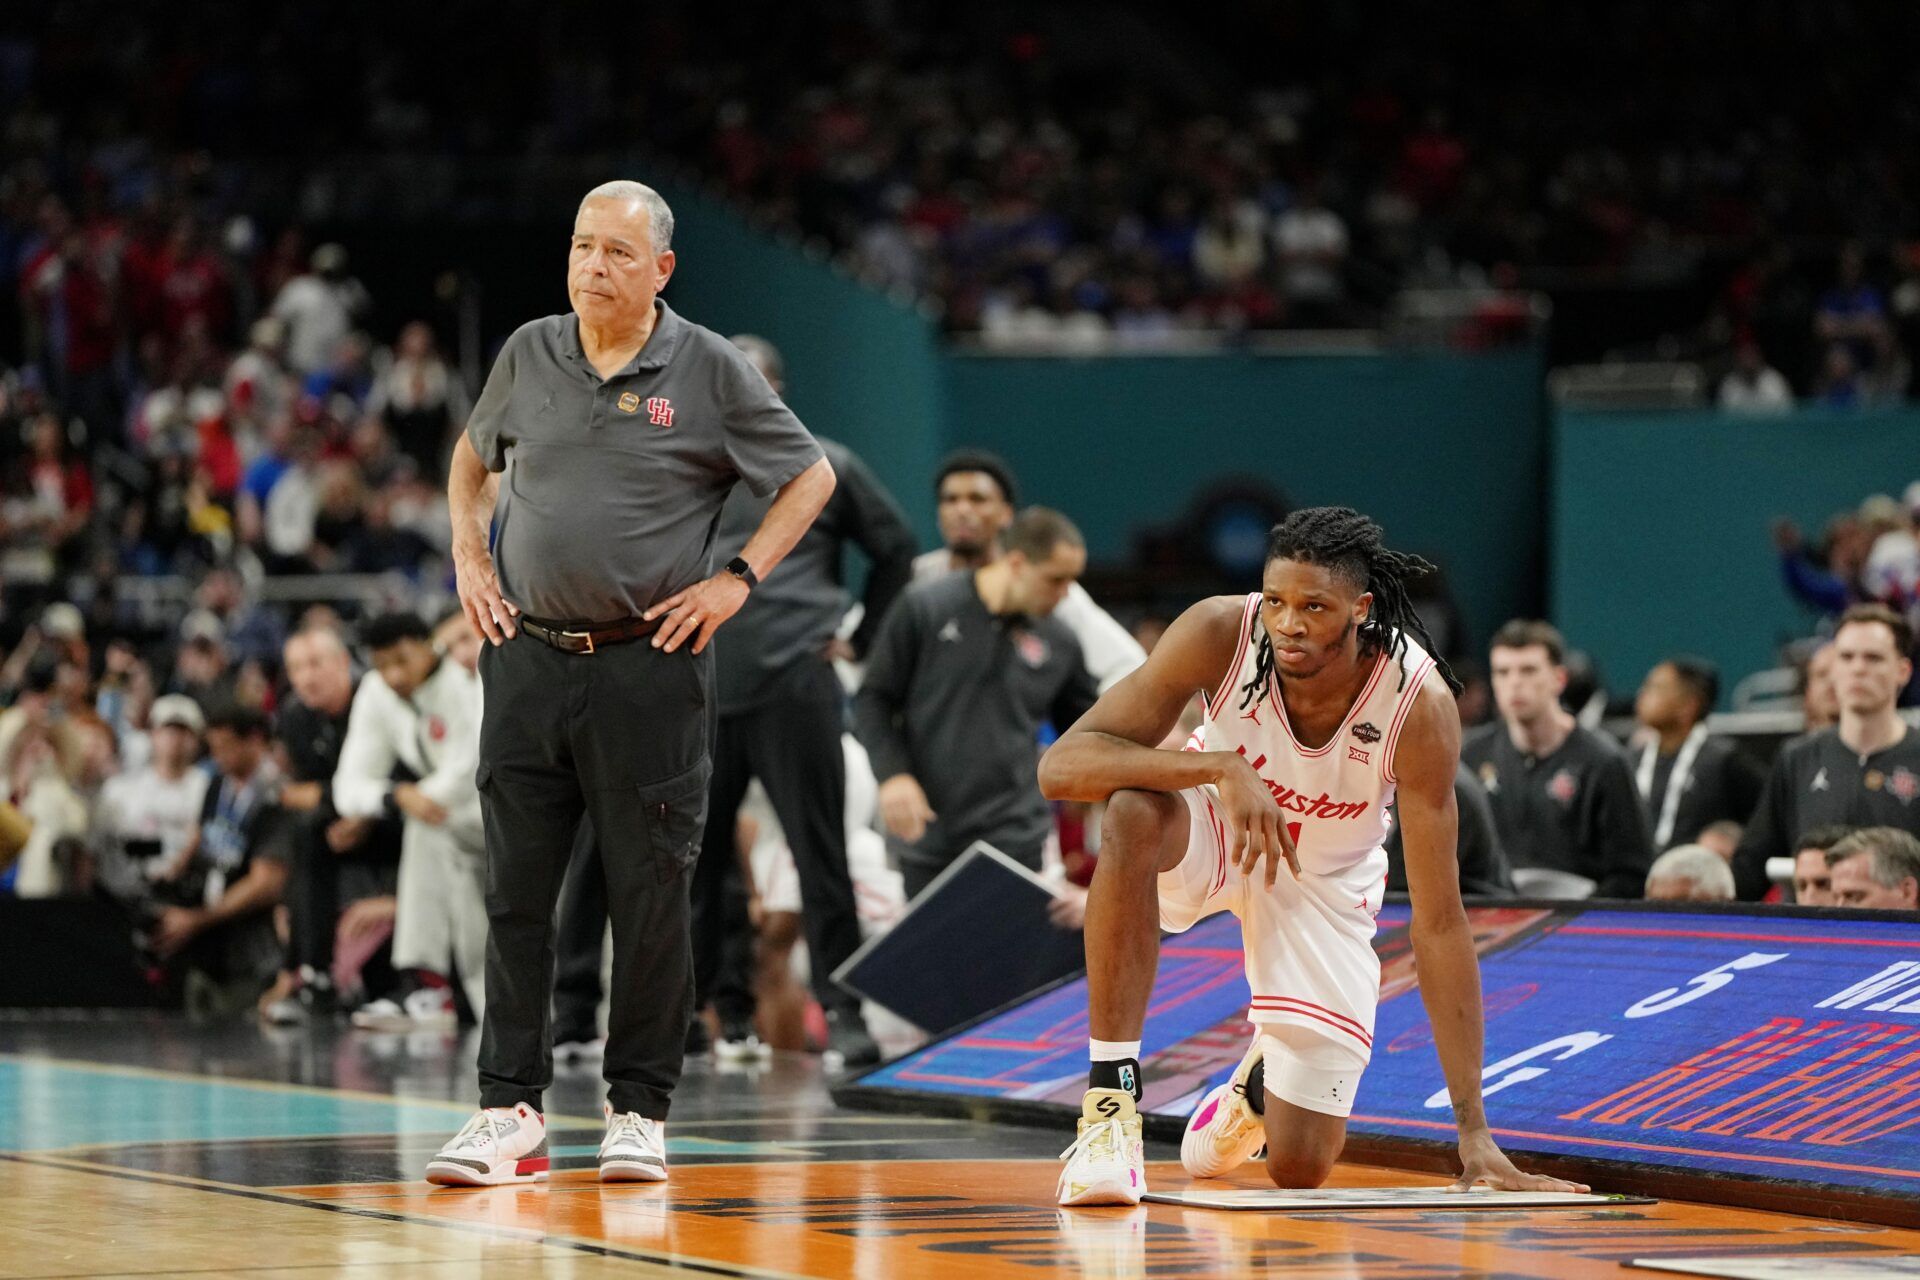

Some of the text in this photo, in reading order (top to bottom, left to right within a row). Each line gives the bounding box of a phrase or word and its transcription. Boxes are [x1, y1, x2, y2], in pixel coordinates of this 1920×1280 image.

[1353, 727, 1380, 739] FINAL FOUR
[1236, 744, 1369, 820] uston
[1625, 952, 1790, 1018] 5
